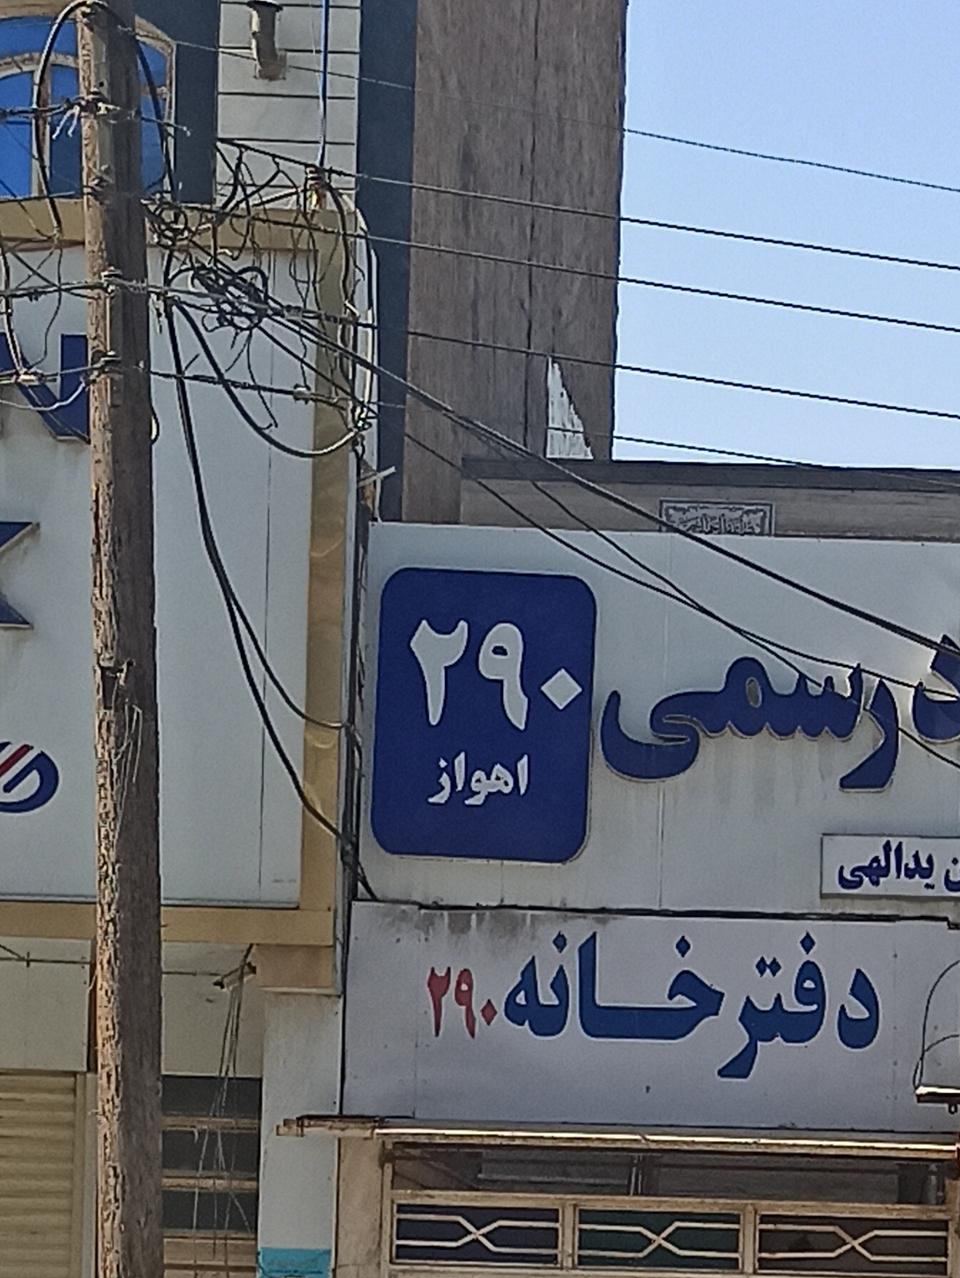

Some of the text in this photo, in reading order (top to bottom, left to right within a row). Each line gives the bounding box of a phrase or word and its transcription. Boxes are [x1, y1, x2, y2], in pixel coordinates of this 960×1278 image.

[409, 618, 583, 731] ۲۹۰
[600, 656, 899, 792] رسمی
[427, 752, 529, 805] اهواز
[837, 840, 934, 890] یدالهی
[427, 965, 498, 1039] ۲۹۰
